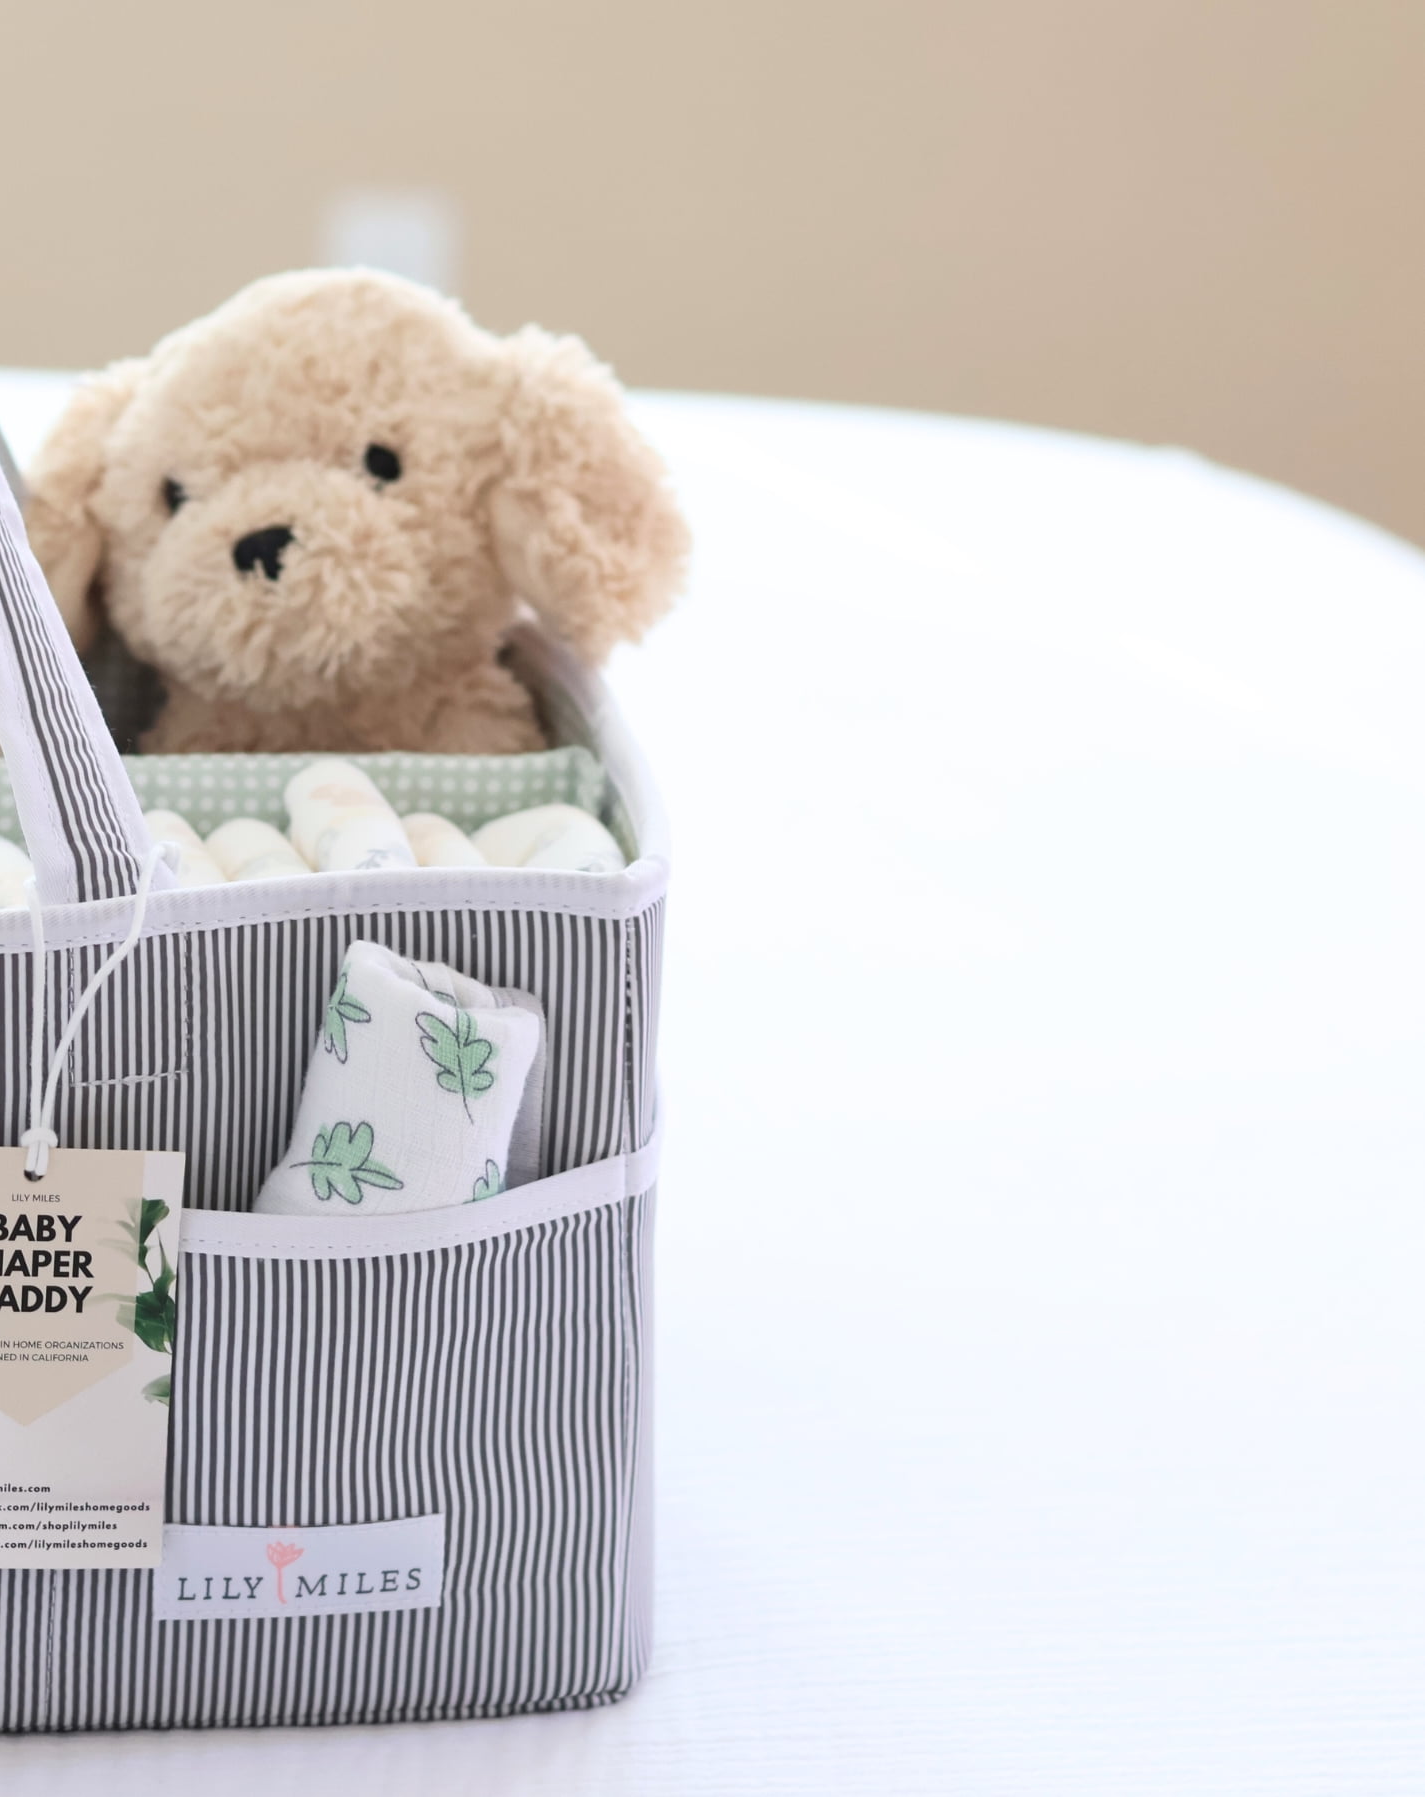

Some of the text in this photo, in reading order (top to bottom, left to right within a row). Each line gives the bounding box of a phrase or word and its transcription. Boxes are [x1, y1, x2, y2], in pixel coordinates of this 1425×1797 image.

[11, 1193, 61, 1203] LILY MILES
[0, 1340, 10, 1349] IN
[12, 1340, 43, 1349] HOME
[44, 1341, 125, 1350] ORGANIZATIONS
[19, 1353, 30, 1361] IN
[31, 1354, 89, 1362] CALIFORNIA
[177, 1567, 422, 1601] LILY MILES
